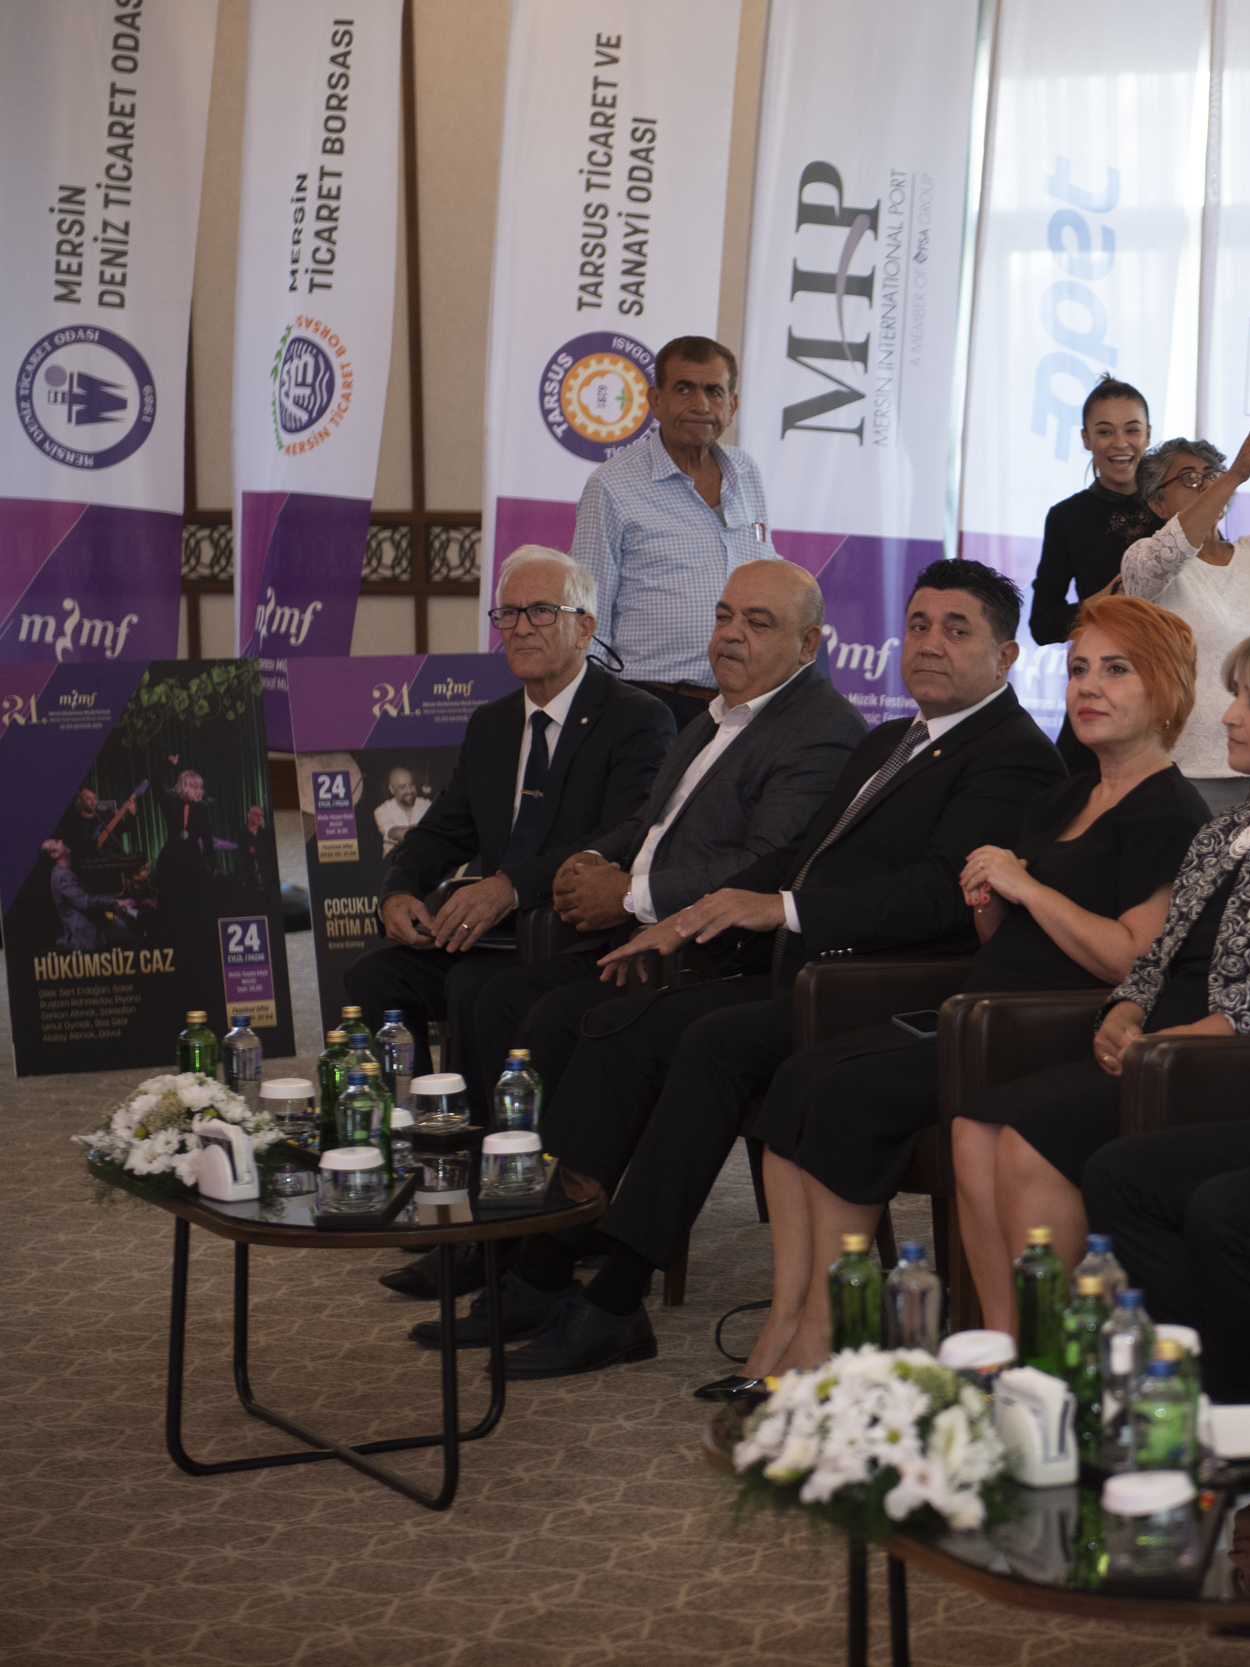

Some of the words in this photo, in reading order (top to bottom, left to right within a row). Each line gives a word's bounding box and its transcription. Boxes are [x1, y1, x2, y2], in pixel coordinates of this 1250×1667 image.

[321, 19, 355, 155] BORSASI
[593, 32, 622, 68] VE
[96, 81, 137, 207] TİCARET
[578, 75, 619, 193] TİCARET
[626, 117, 658, 203] ODASI
[288, 173, 308, 293] MERSİN
[305, 165, 343, 294] TİCARET
[888, 168, 909, 215] PORT
[49, 184, 86, 304] MERSİN
[92, 219, 130, 309] DENİZ
[576, 202, 610, 312] TARSUS
[617, 211, 651, 316] SANAYİ
[781, 160, 881, 446] MIP
[876, 221, 905, 373] INTERNATIONAL
[611, 336, 651, 365] ODASI
[543, 352, 574, 439] TARSUS
[873, 376, 895, 448] MERSIN
[880, 694, 920, 709] Festiva
[317, 774, 346, 800] 24
[34, 947, 136, 981] HÜKÜMSÜZ
[139, 948, 175, 974] CAZ
[227, 922, 261, 954] 24
[325, 916, 361, 938] RİTİM
